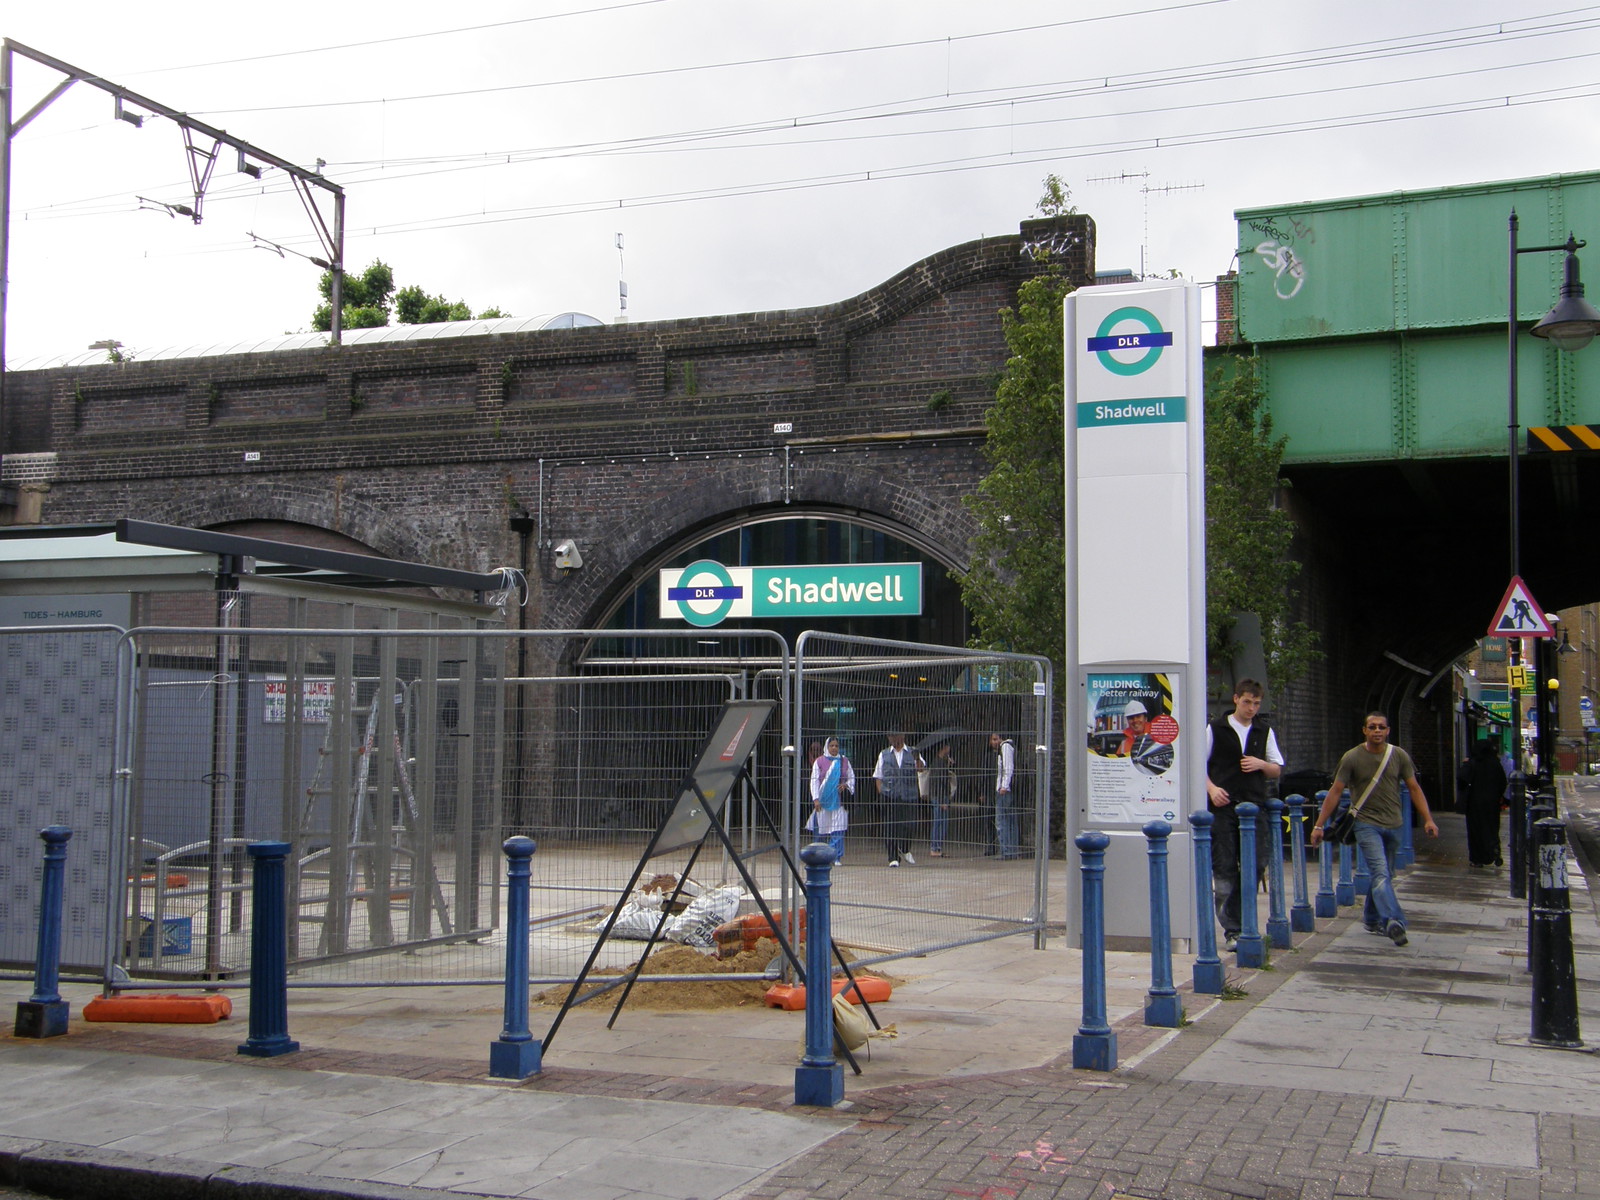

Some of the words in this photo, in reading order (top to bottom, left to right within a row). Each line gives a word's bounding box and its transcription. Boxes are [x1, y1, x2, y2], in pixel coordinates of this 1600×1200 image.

[1118, 336, 1140, 347] DLR
[1095, 402, 1166, 419] Shadwell
[695, 588, 715, 598] DLR
[767, 575, 904, 604] Shadwell
[23, 611, 49, 619] TIDES
[57, 610, 103, 618] HAMBURG
[1100, 689, 1126, 697] better
[1129, 689, 1159, 699] railway
